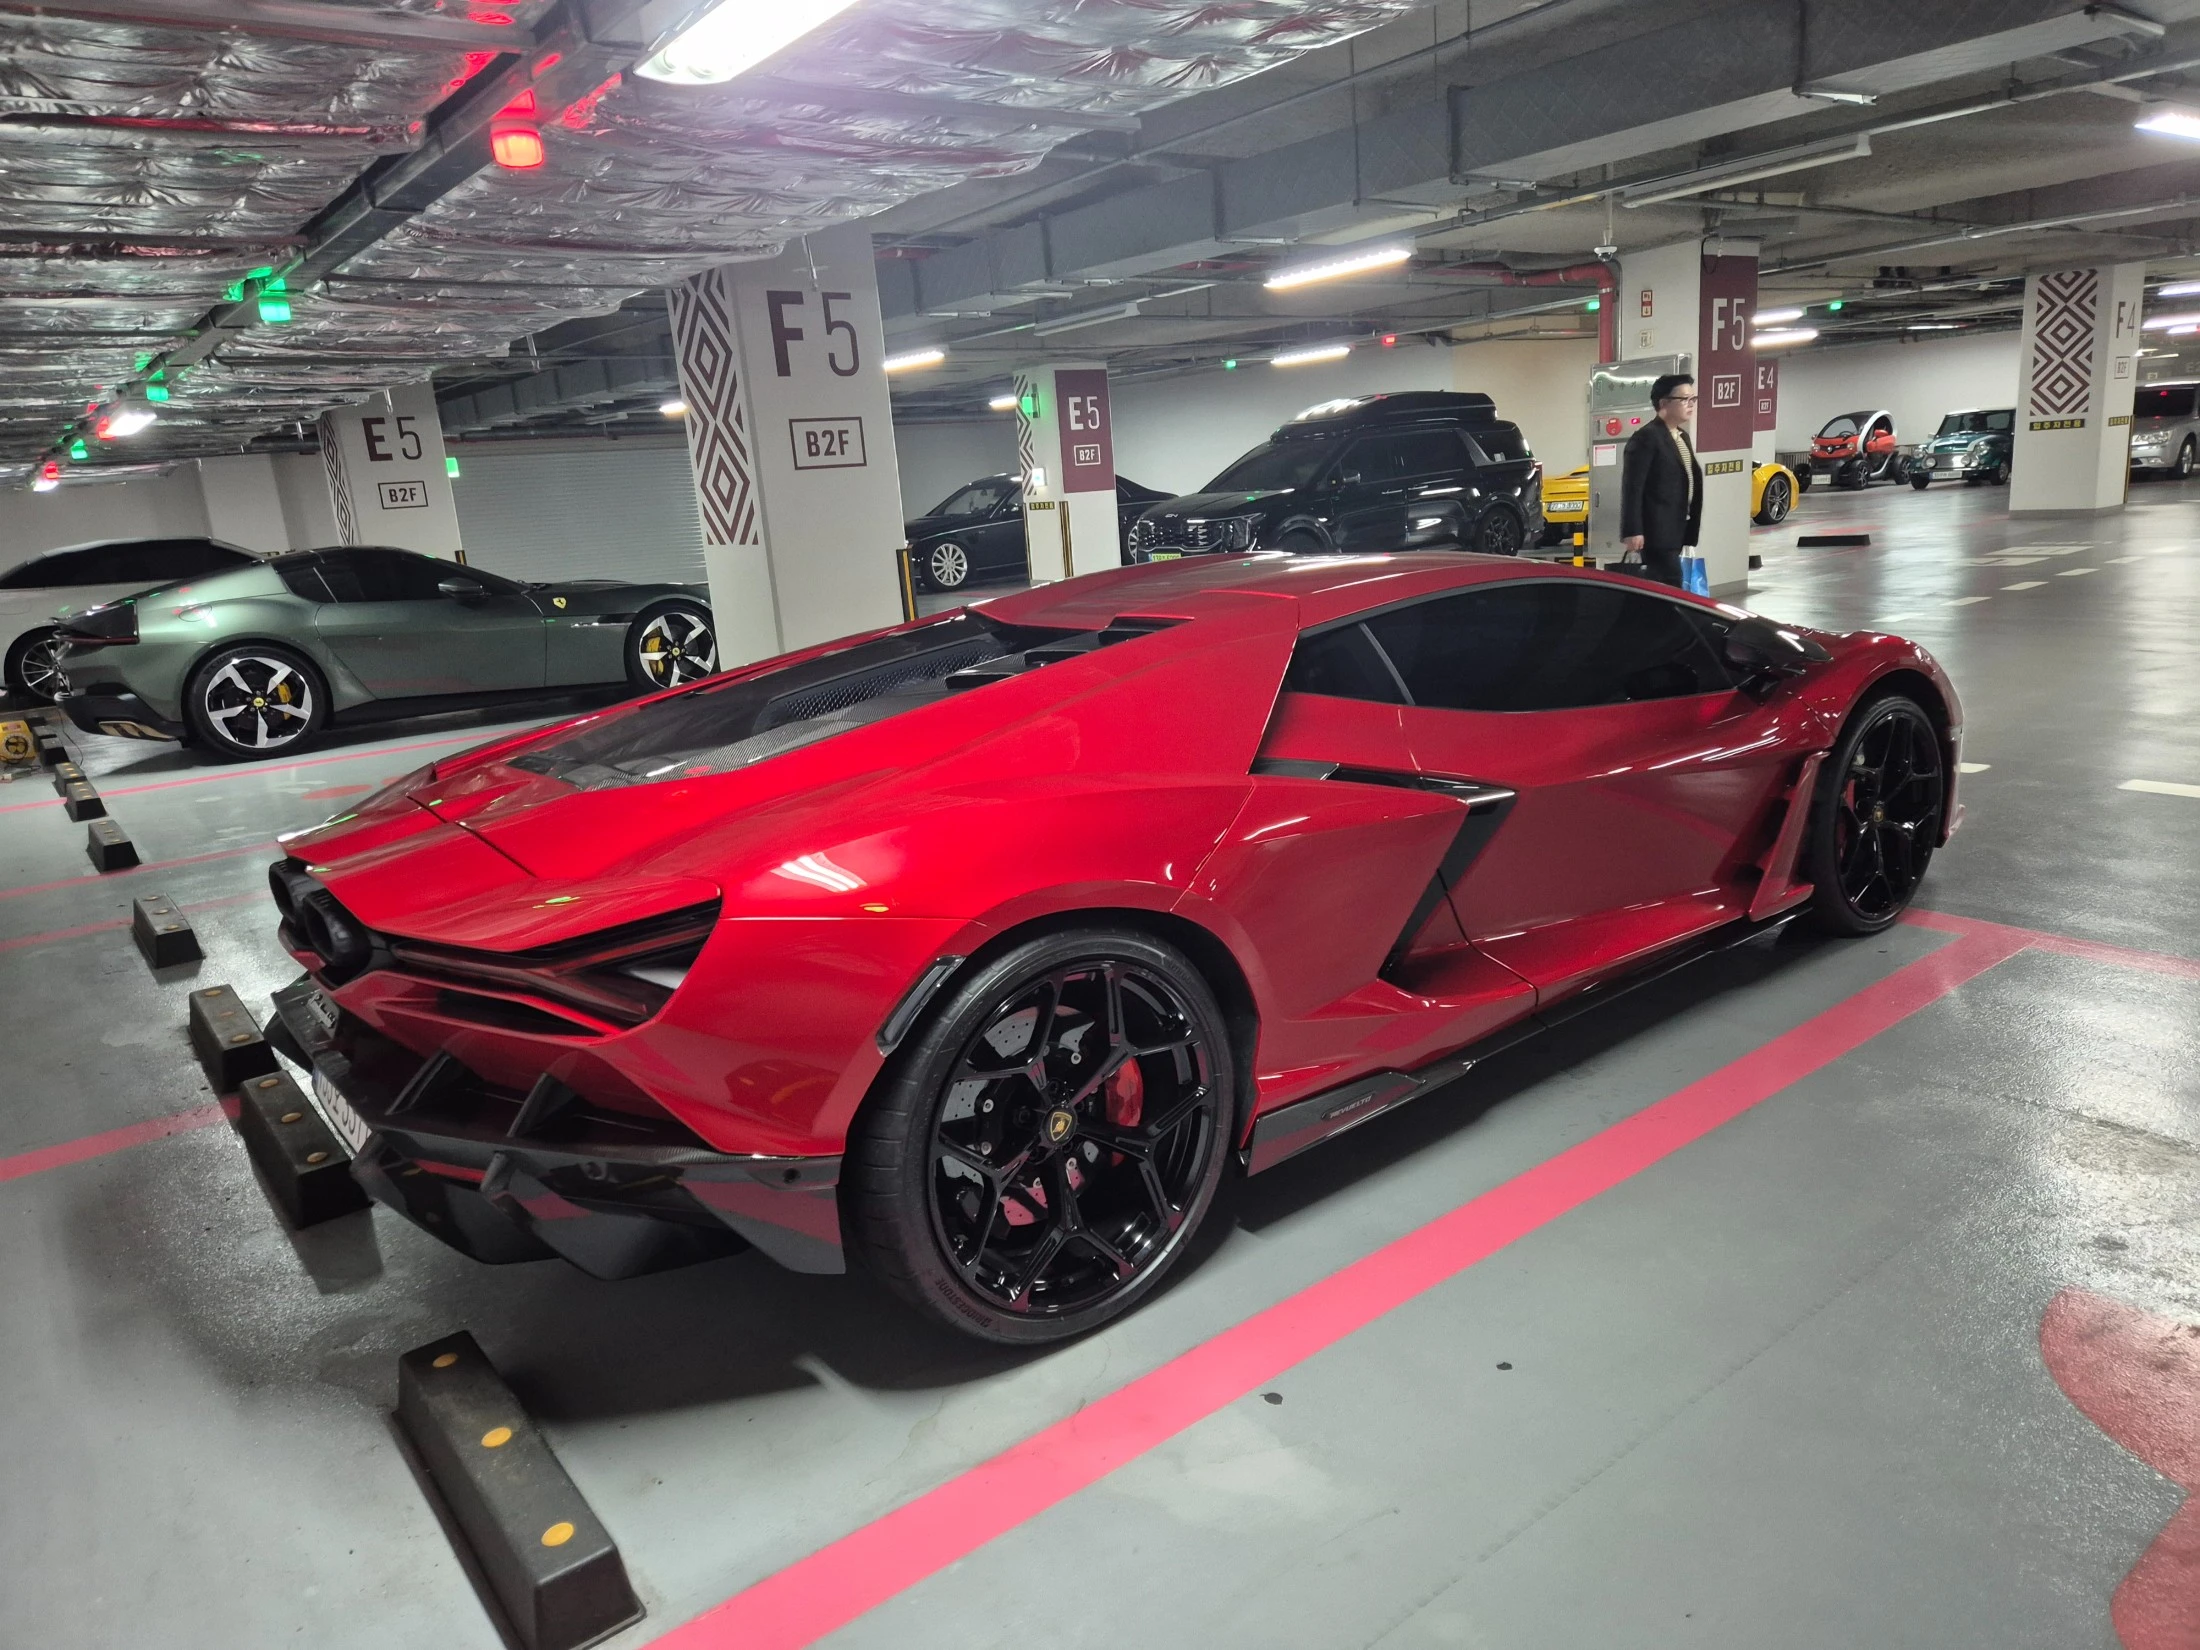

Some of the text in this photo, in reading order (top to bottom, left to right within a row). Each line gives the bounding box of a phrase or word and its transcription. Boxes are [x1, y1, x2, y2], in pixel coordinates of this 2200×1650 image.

[1717, 382, 1736, 400] B2F
[806, 429, 850, 457] B2F
[1079, 449, 1095, 461] B2F
[388, 487, 417, 503] B2F
